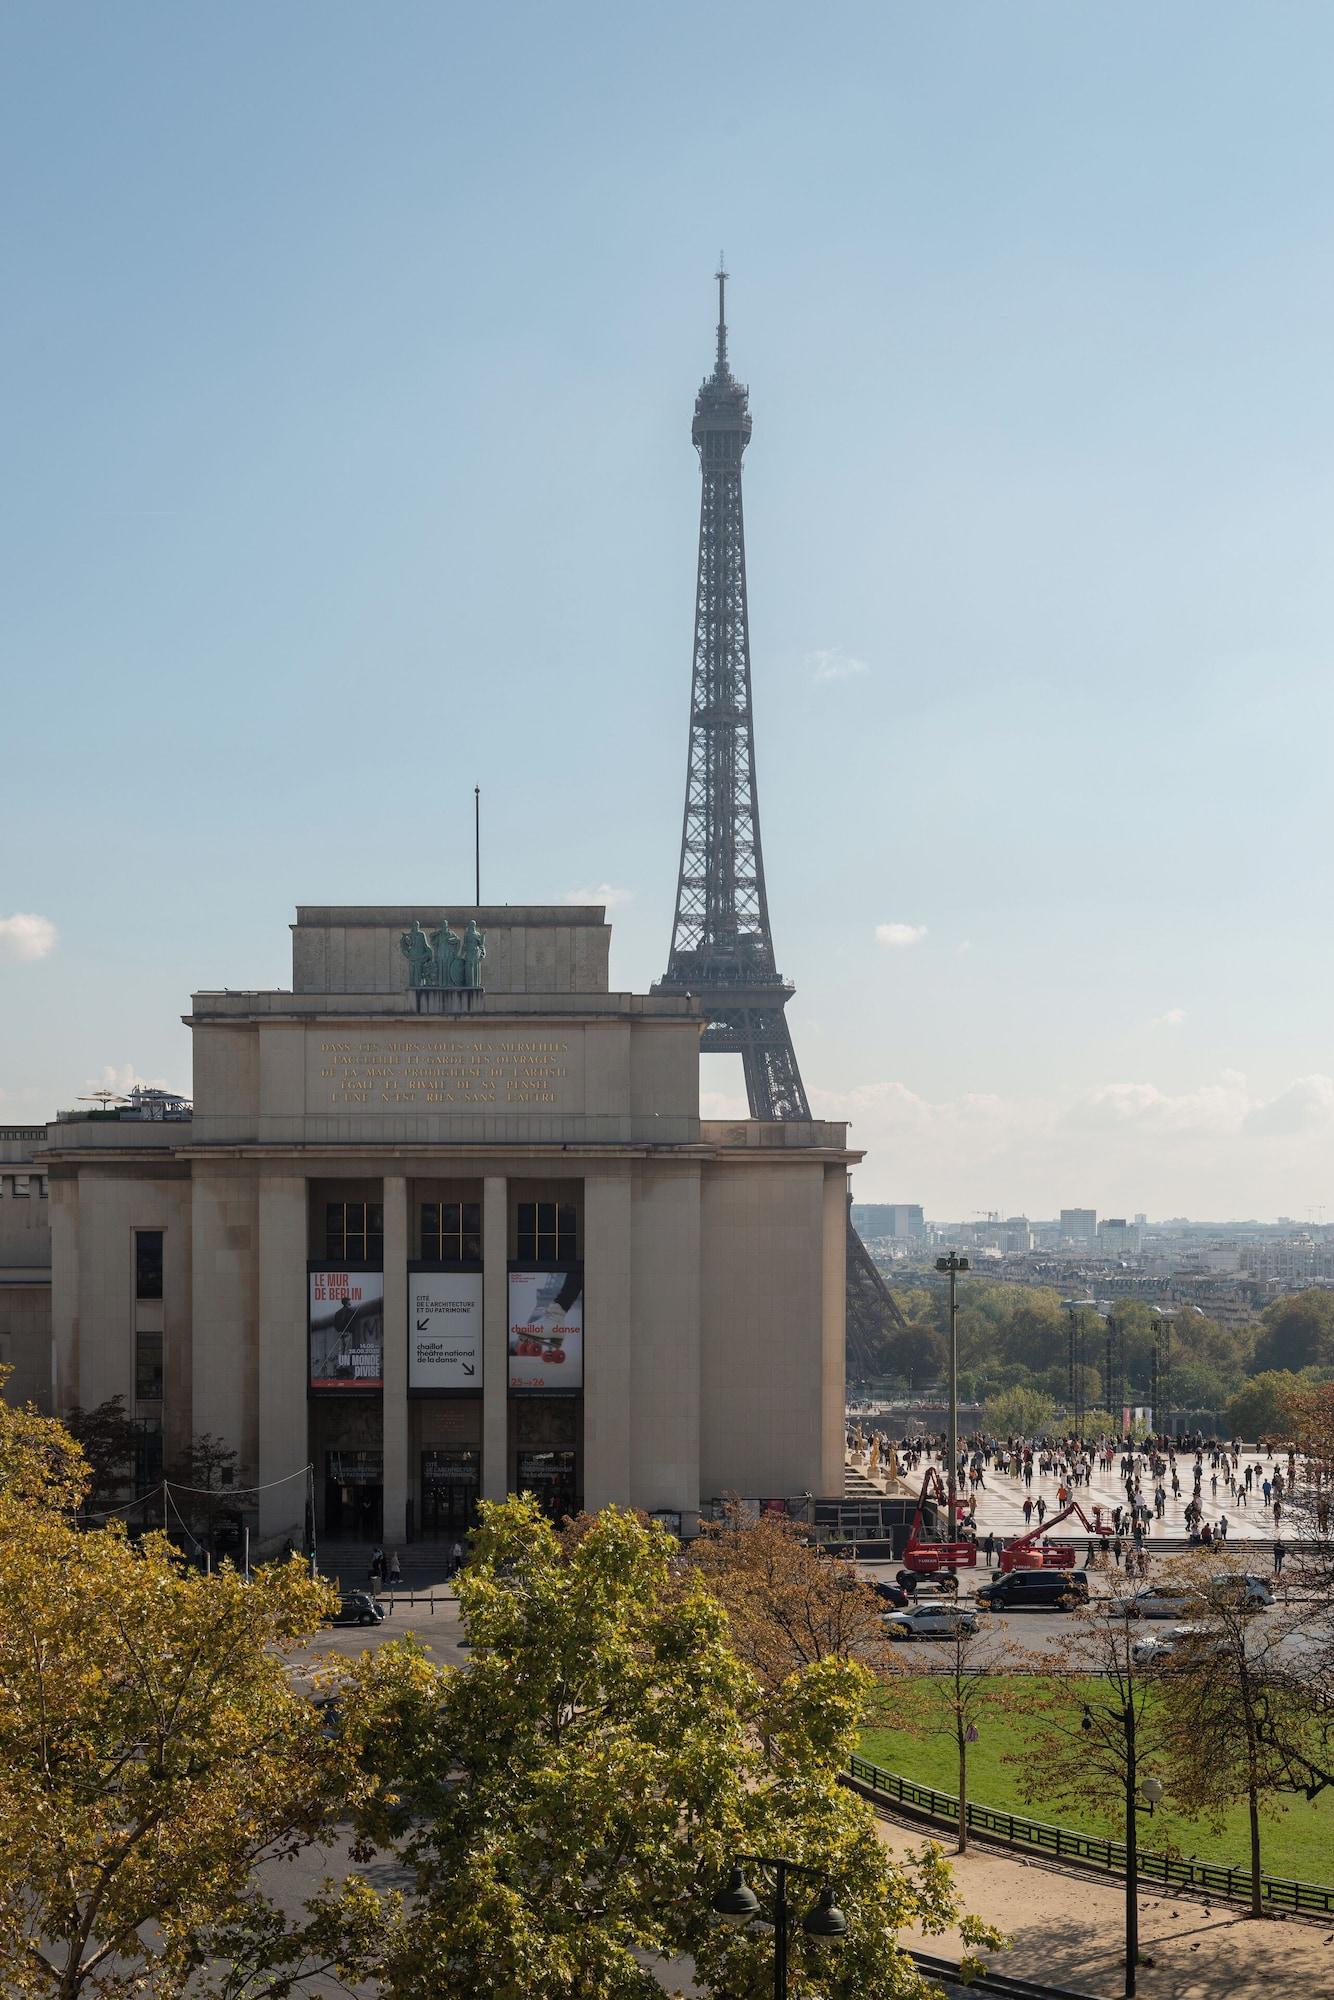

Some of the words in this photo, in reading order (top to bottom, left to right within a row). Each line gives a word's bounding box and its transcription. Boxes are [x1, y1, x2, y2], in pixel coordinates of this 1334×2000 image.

[426, 1055, 464, 1065] GARDE
[496, 1055, 557, 1065] OUVRAGES
[409, 1080, 447, 1089] RIVALE
[457, 1080, 472, 1089] DE
[481, 1080, 496, 1089] SA
[426, 1093, 456, 1102] RIEN
[464, 1093, 496, 1102] SANS
[314, 1274, 325, 1287] LE
[327, 1274, 349, 1287] MUR
[314, 1287, 326, 1301] DE
[329, 1287, 362, 1301] BERLIN
[511, 1323, 545, 1333] chaillot
[552, 1323, 581, 1333] danse
[444, 1349, 475, 1357] national
[338, 1354, 351, 1366] UN
[351, 1354, 381, 1366] MONDE
[511, 1377, 523, 1387] 25
[532, 1377, 545, 1387] 26
